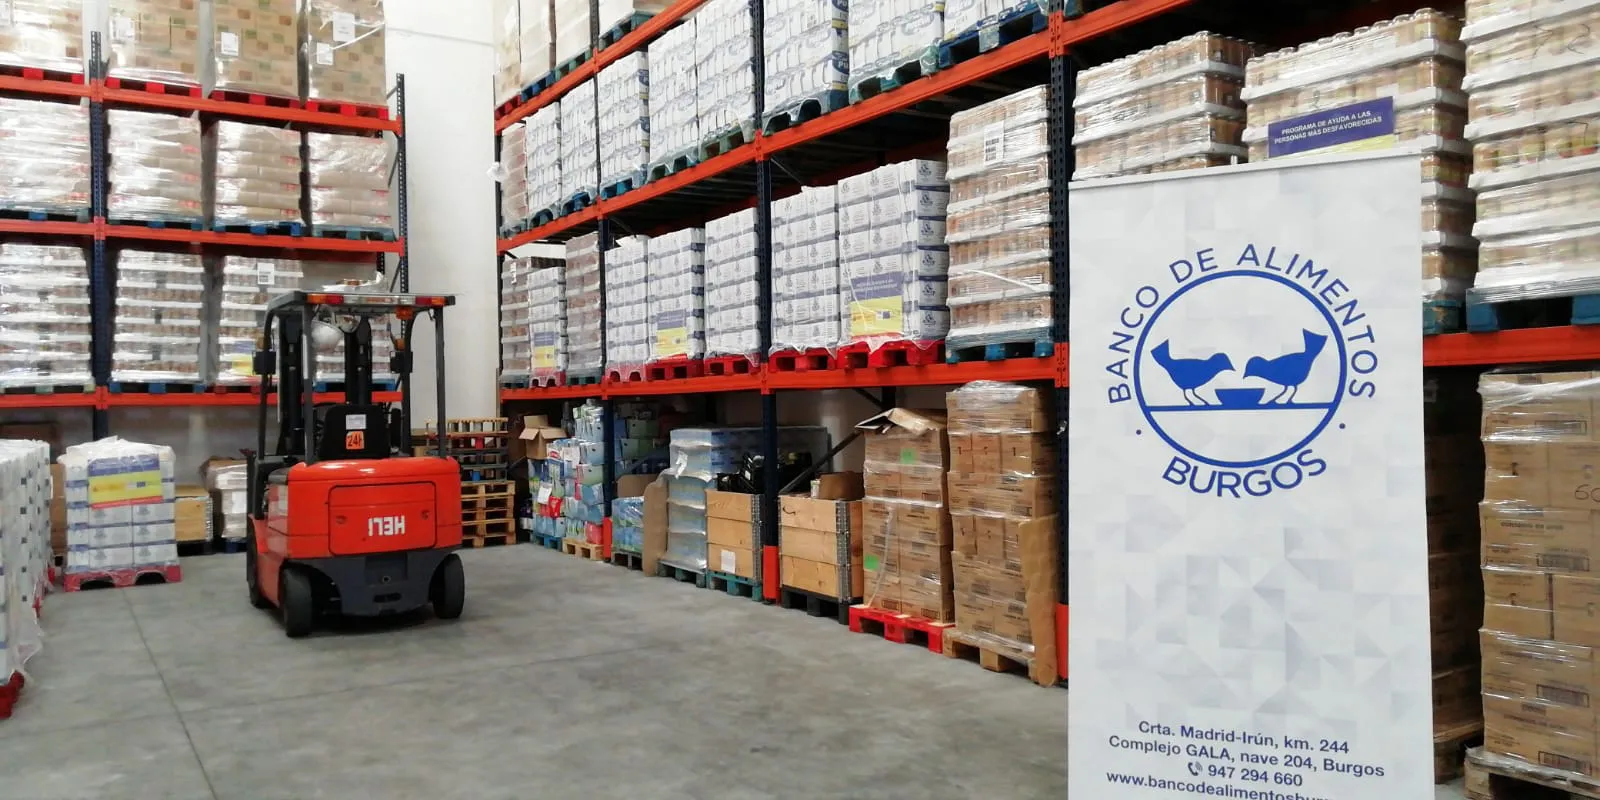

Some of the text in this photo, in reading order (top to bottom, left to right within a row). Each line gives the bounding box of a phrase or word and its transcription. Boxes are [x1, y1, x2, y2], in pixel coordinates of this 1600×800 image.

[1274, 131, 1307, 145] PERSONAS
[1322, 116, 1382, 134] DESFAVORECIDAS
[1281, 110, 1372, 135] PROGRAMA DE AYUDA A LAS
[1106, 243, 1379, 404] BANCO DE ALIMENTOS
[1162, 448, 1327, 499] BURGOS
[368, 515, 406, 537] HELI
[1138, 720, 1350, 755] Crta. Madrid-Irún, km. 244
[1108, 734, 1385, 778] Complejo GALA, nave 204, Burgos
[1106, 771, 1331, 800] www.bancodealimentosb
[1207, 763, 1303, 787] 947 294 660
